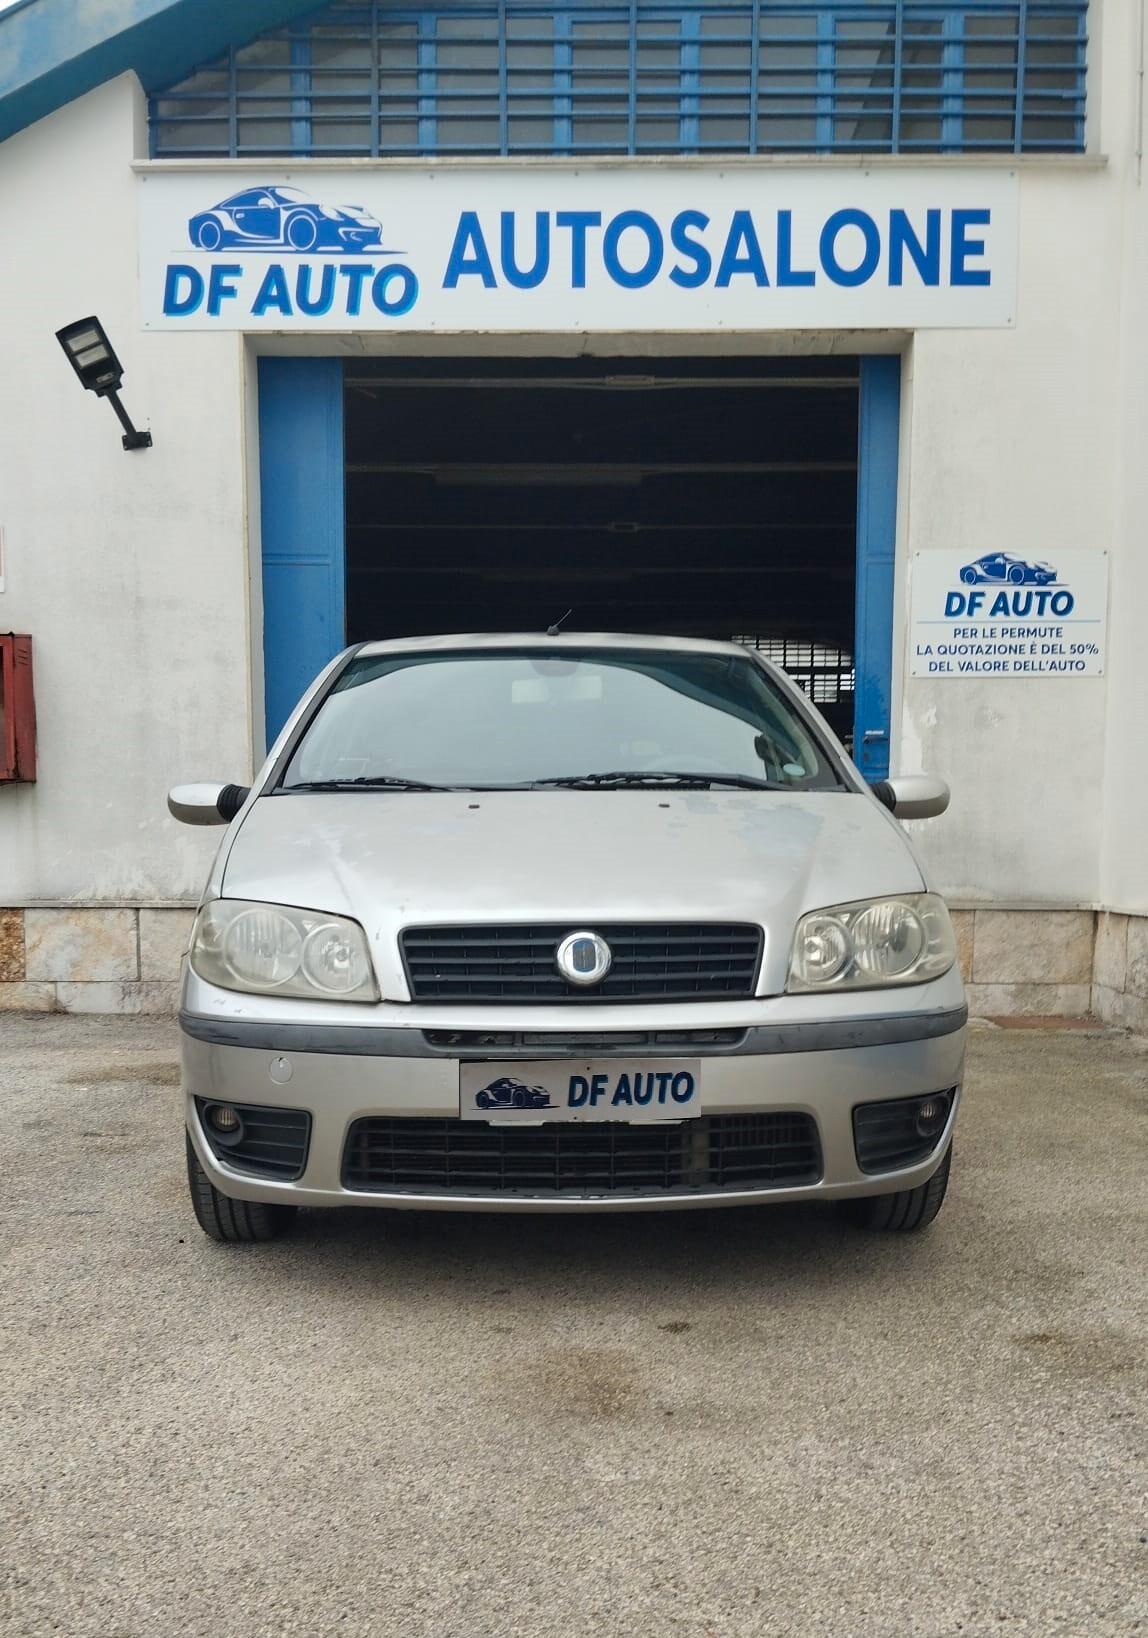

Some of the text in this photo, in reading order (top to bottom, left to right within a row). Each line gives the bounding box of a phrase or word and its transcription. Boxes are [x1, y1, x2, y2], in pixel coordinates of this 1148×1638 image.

[442, 208, 991, 289] AUTOSALONE
[162, 262, 420, 317] DF AUTO
[944, 590, 1075, 617] DF AUTO
[953, 627, 1063, 639] PER LE PERMUTE
[916, 641, 1099, 656] LA QUOTAZIONE È DEL 50%
[928, 660, 1086, 672] DEL VALORE DELL'AUTO
[567, 1071, 695, 1108] DF AUTO
